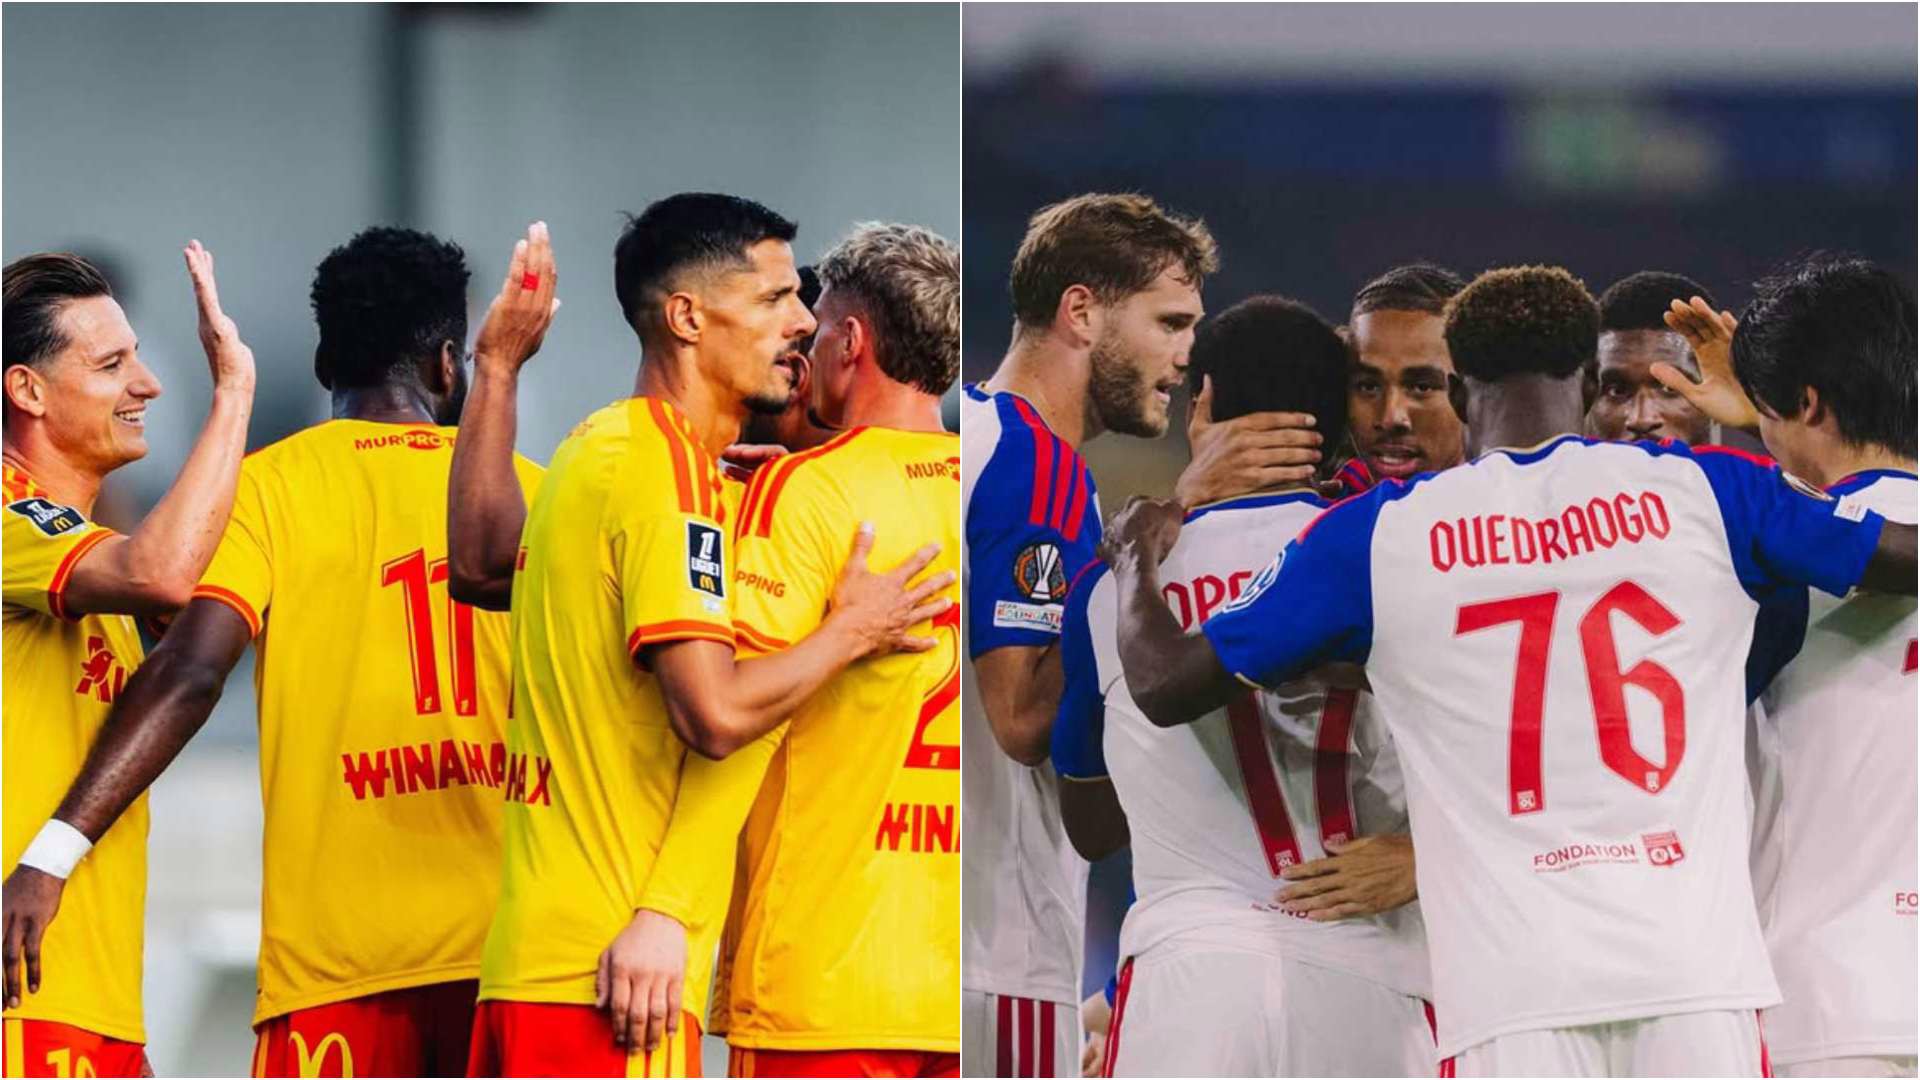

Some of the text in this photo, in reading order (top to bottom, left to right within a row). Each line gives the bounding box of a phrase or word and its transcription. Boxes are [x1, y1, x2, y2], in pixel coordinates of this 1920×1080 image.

[1430, 491, 1671, 572] OUEDRAOGO
[382, 547, 477, 716] 11
[1453, 580, 1685, 816] 76
[875, 803, 960, 853] WIN
[1534, 844, 1636, 867] FONDATION
